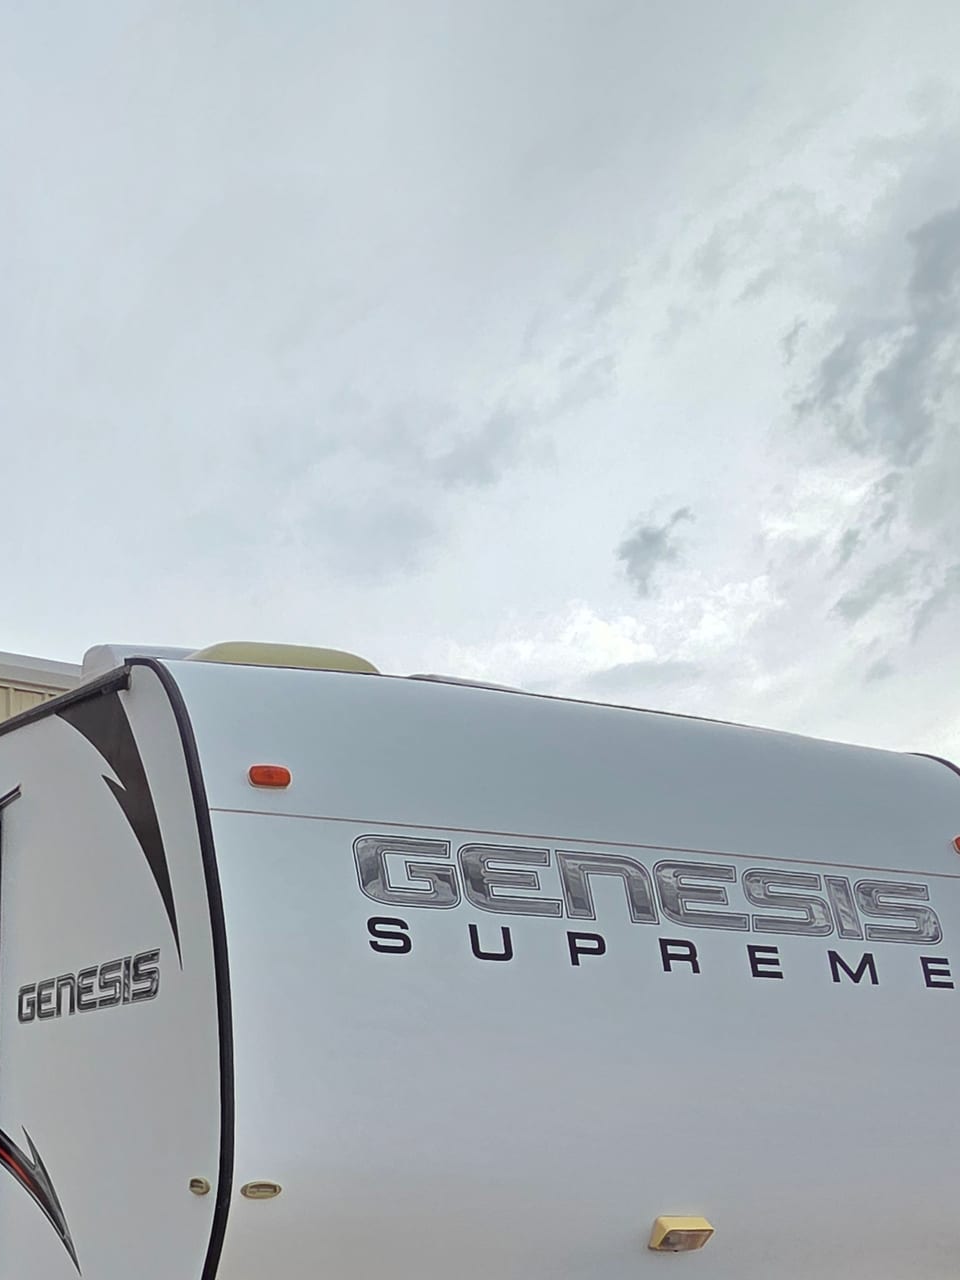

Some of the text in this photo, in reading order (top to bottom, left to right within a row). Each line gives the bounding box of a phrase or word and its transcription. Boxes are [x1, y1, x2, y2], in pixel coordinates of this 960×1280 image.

[352, 833, 944, 946] GENESIS
[18, 948, 161, 1024] GENESIS
[367, 917, 955, 989] SUPREME
